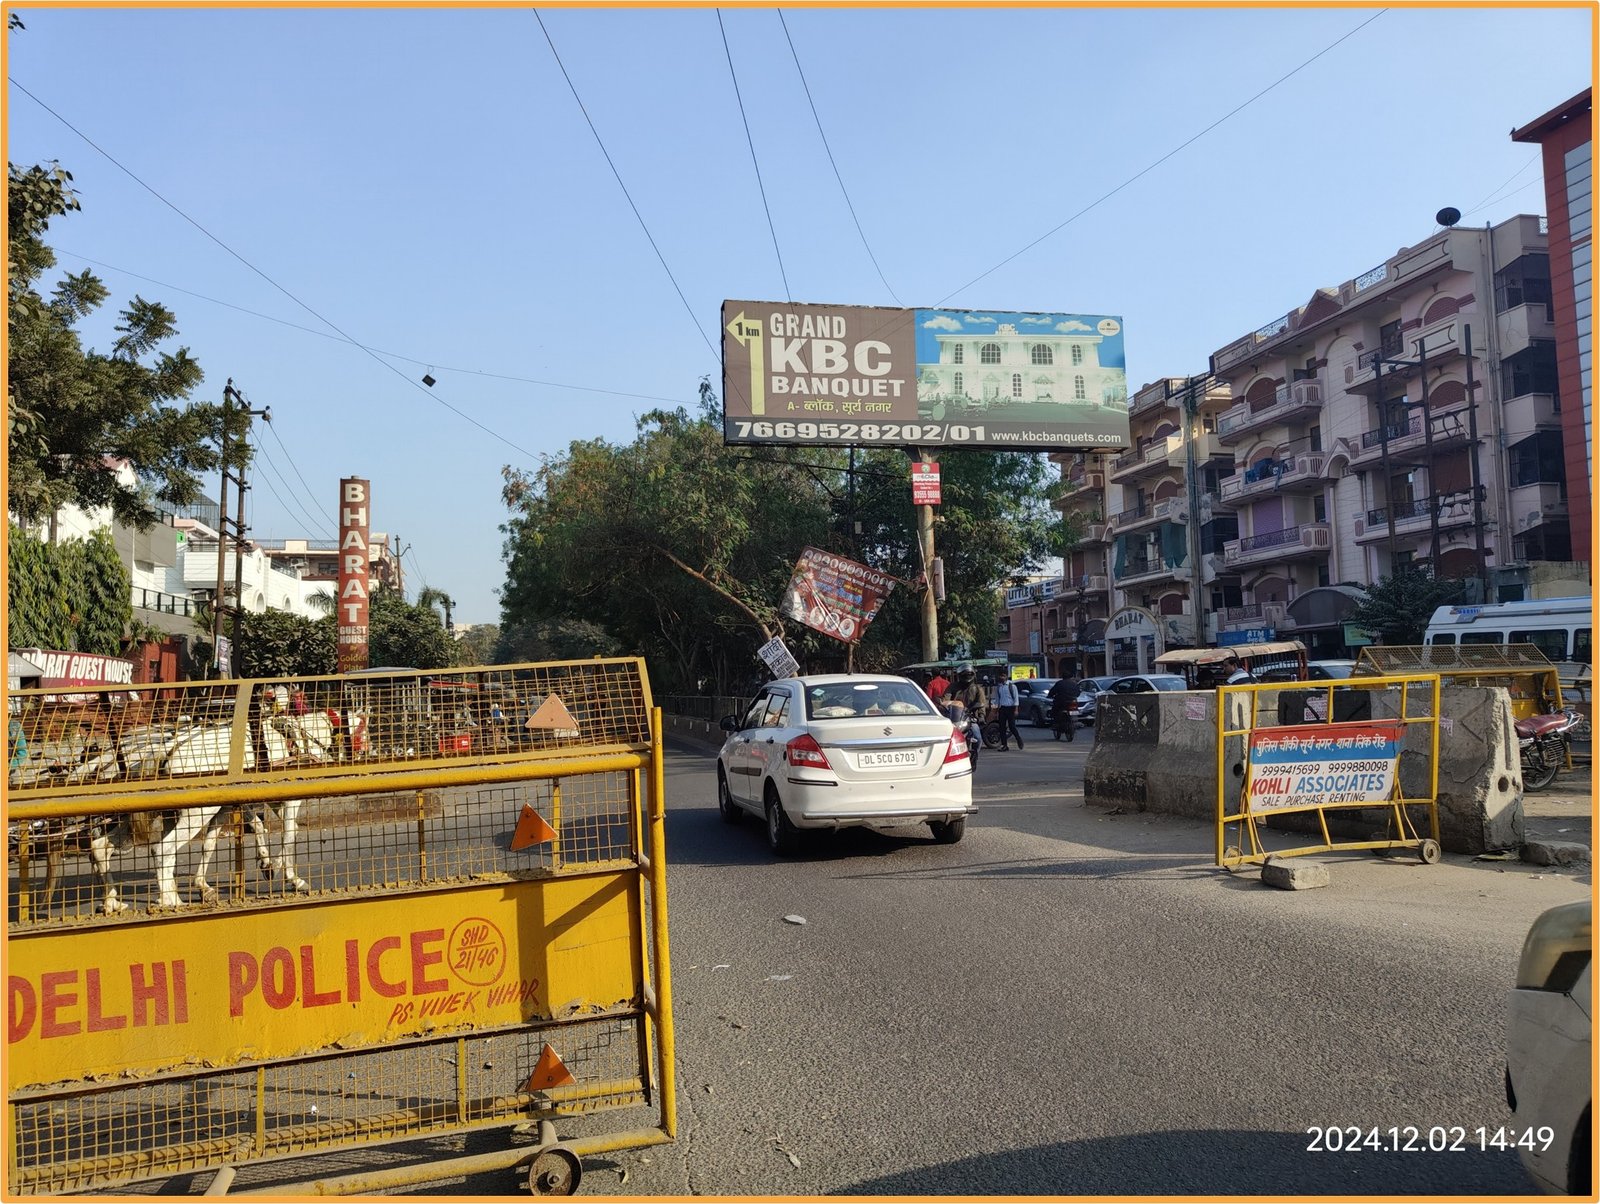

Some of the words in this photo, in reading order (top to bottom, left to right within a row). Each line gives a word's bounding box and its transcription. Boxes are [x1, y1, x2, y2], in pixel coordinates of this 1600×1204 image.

[735, 322, 743, 336] 1
[746, 327, 760, 336] km
[770, 313, 846, 339] GRAND
[771, 338, 892, 376] KBC
[772, 376, 905, 397] BANQUET
[842, 399, 861, 415] सूर्य
[865, 402, 892, 413] नगर
[735, 421, 986, 442] 7669528202/01
[992, 430, 1121, 444] www.kbcbanquets.com
[342, 484, 367, 623] BHARAT
[1009, 586, 1028, 600] LITTLE
[340, 626, 367, 634] GUEST
[1115, 612, 1144, 630] BHARAT
[340, 635, 367, 644] HOUSE
[340, 654, 367, 662] Golden
[70, 655, 104, 680] GUEST
[105, 660, 134, 684] HOUSE
[1256, 738, 1278, 757] पुलिस
[1279, 736, 1299, 752] चौकी
[1300, 735, 1315, 754] सूर्य
[1337, 737, 1352, 748] थाना
[1354, 734, 1371, 749] लिंक
[864, 755, 875, 765] DL
[895, 753, 915, 763] 6703
[1261, 763, 1320, 776] 9999415699
[1328, 761, 1388, 773] 9999880098
[1251, 777, 1291, 796] KOHLI
[1295, 774, 1385, 794] ASSOCIATES
[1262, 796, 1280, 806] SALE
[1284, 794, 1325, 805] PURCHASE
[1328, 792, 1366, 803] RENTING
[461, 925, 489, 947] SHD
[8, 959, 188, 1044] DELHI
[228, 929, 450, 1017] POLICE
[418, 990, 480, 1018] VIVEK
[487, 978, 540, 1008] VIHAR
